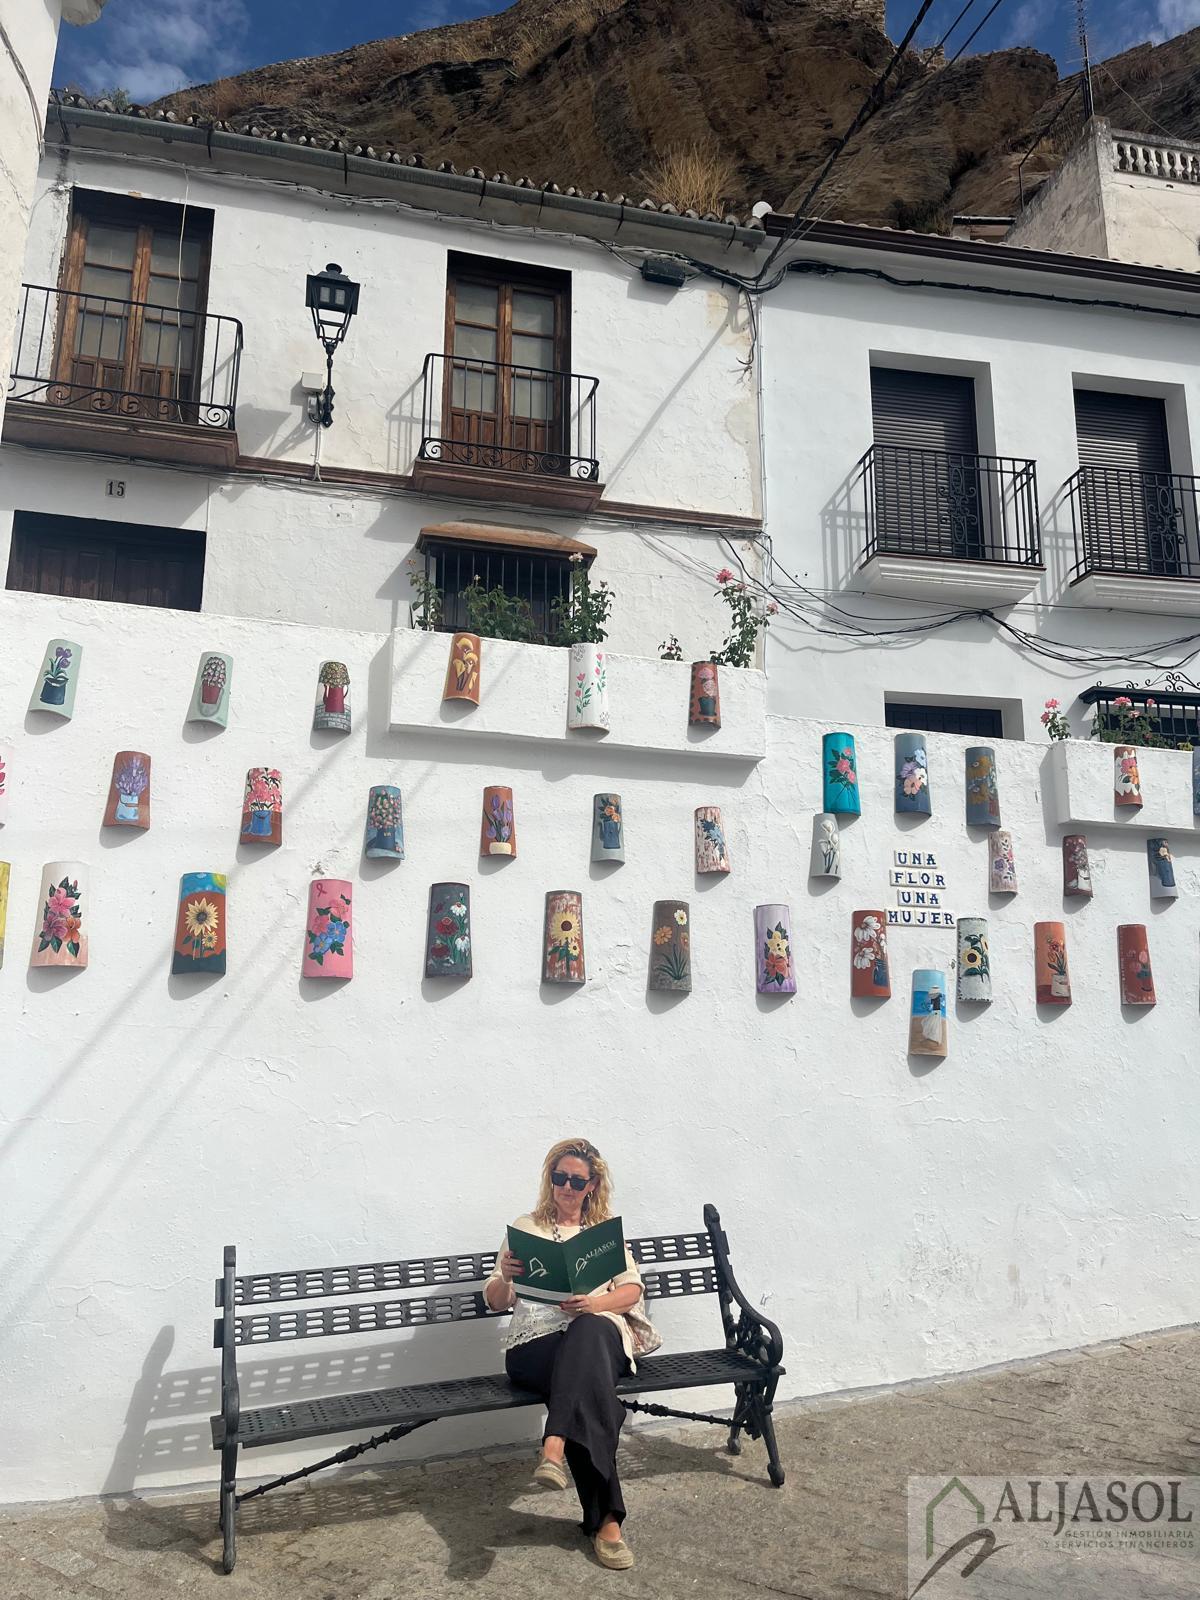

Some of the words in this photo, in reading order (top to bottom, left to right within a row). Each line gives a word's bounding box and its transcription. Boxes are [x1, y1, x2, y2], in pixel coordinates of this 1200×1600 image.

[107, 480, 125, 497] 15
[897, 852, 937, 865] UNA
[894, 872, 945, 886] FLOR
[901, 891, 939, 905] UNA
[888, 910, 954, 925] MUJER
